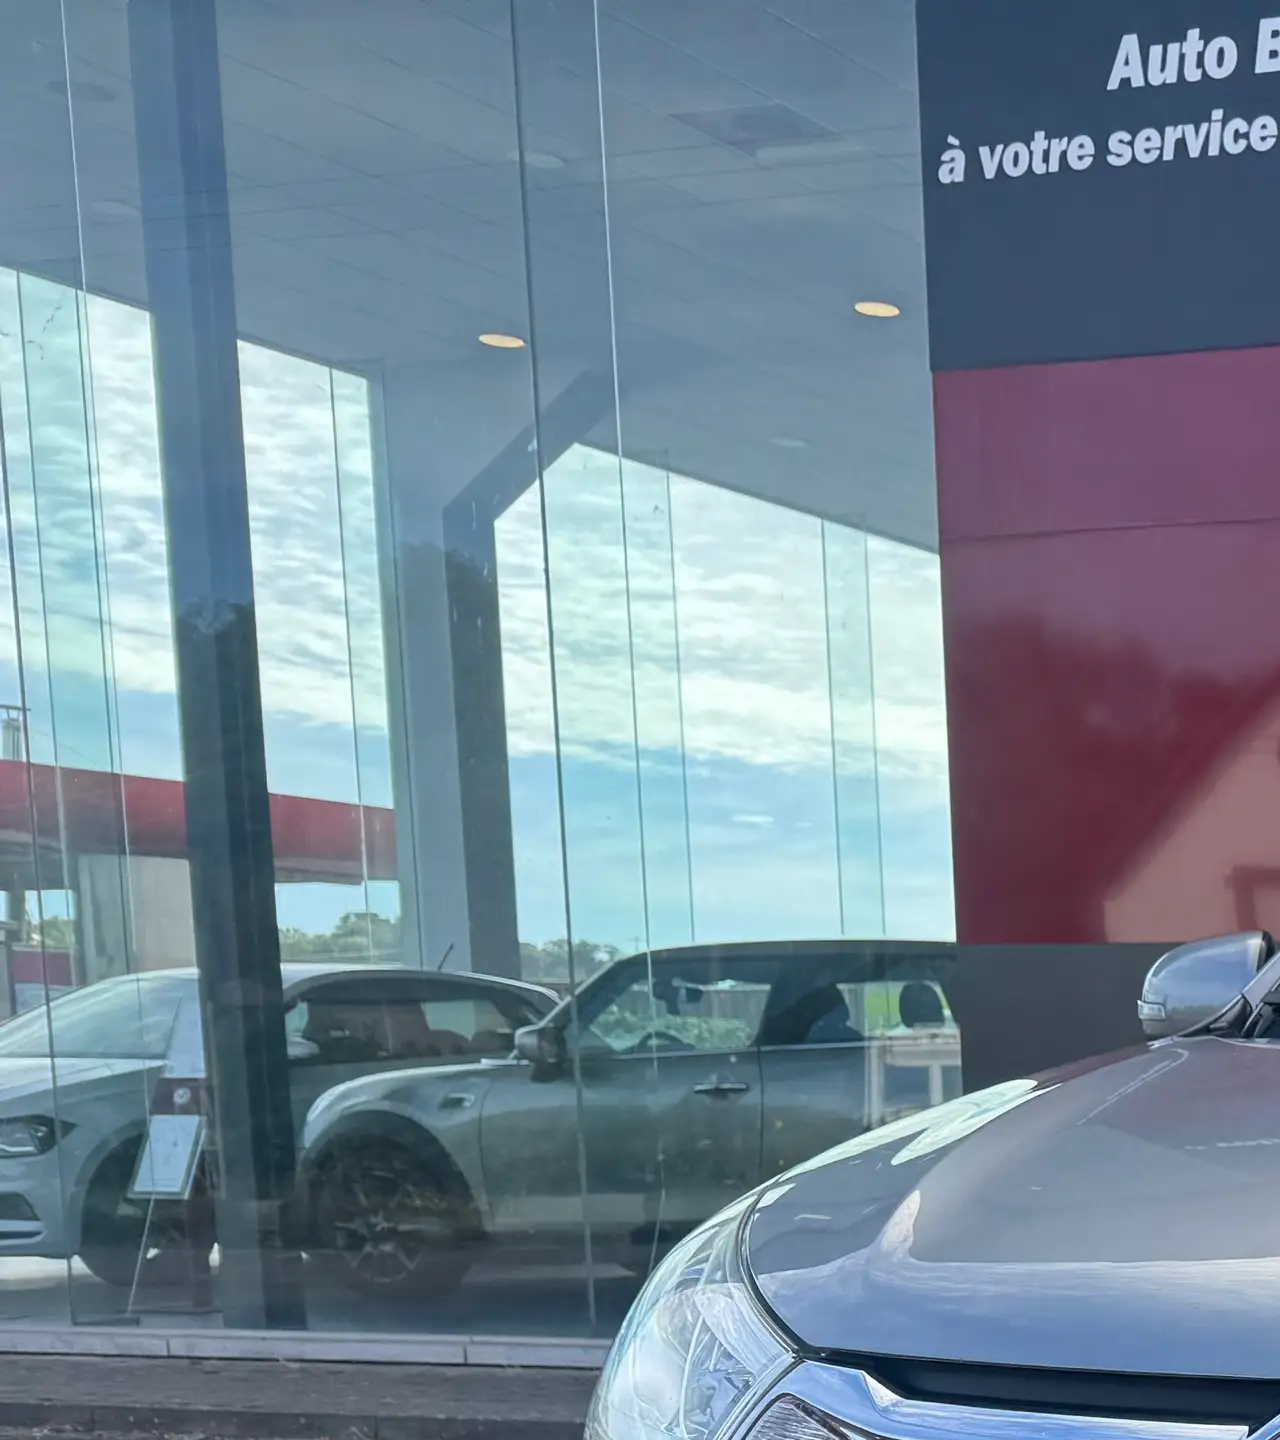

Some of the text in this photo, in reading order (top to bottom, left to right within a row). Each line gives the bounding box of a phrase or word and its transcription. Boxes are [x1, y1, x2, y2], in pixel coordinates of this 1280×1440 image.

[1106, 27, 1238, 91] Auto
[938, 134, 966, 184] à
[979, 130, 1095, 180] votre
[1106, 108, 1278, 167] service
